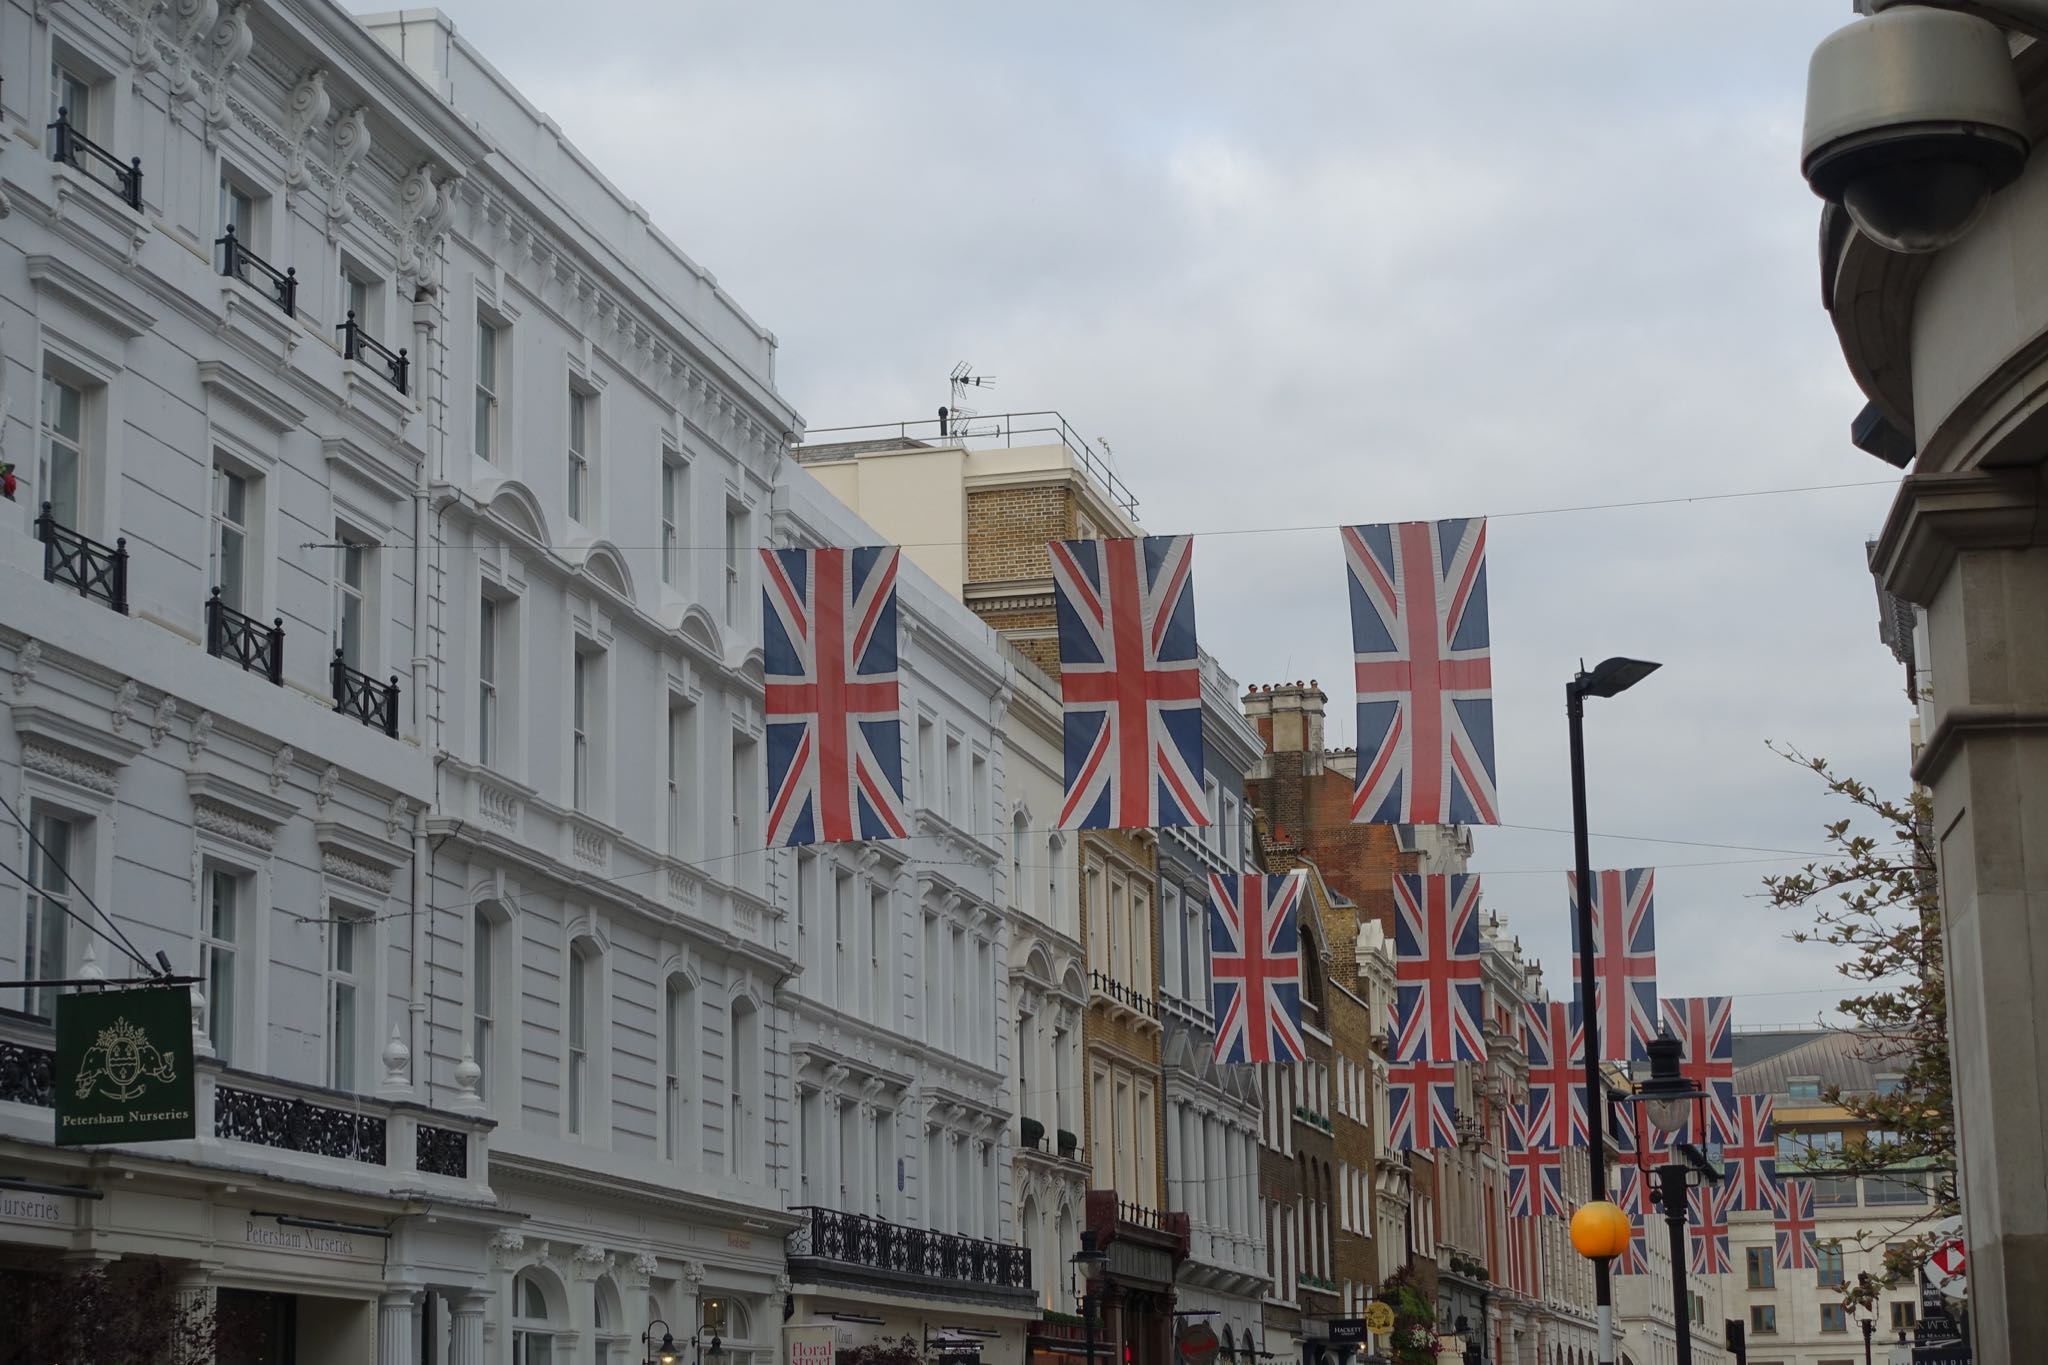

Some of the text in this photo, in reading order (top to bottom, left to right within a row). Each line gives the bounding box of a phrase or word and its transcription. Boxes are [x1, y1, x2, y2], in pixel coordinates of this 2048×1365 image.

[62, 1109, 189, 1126] Petersham Nurseries
[245, 1219, 353, 1255] Petersham Nurseries
[792, 1340, 832, 1357] floral
